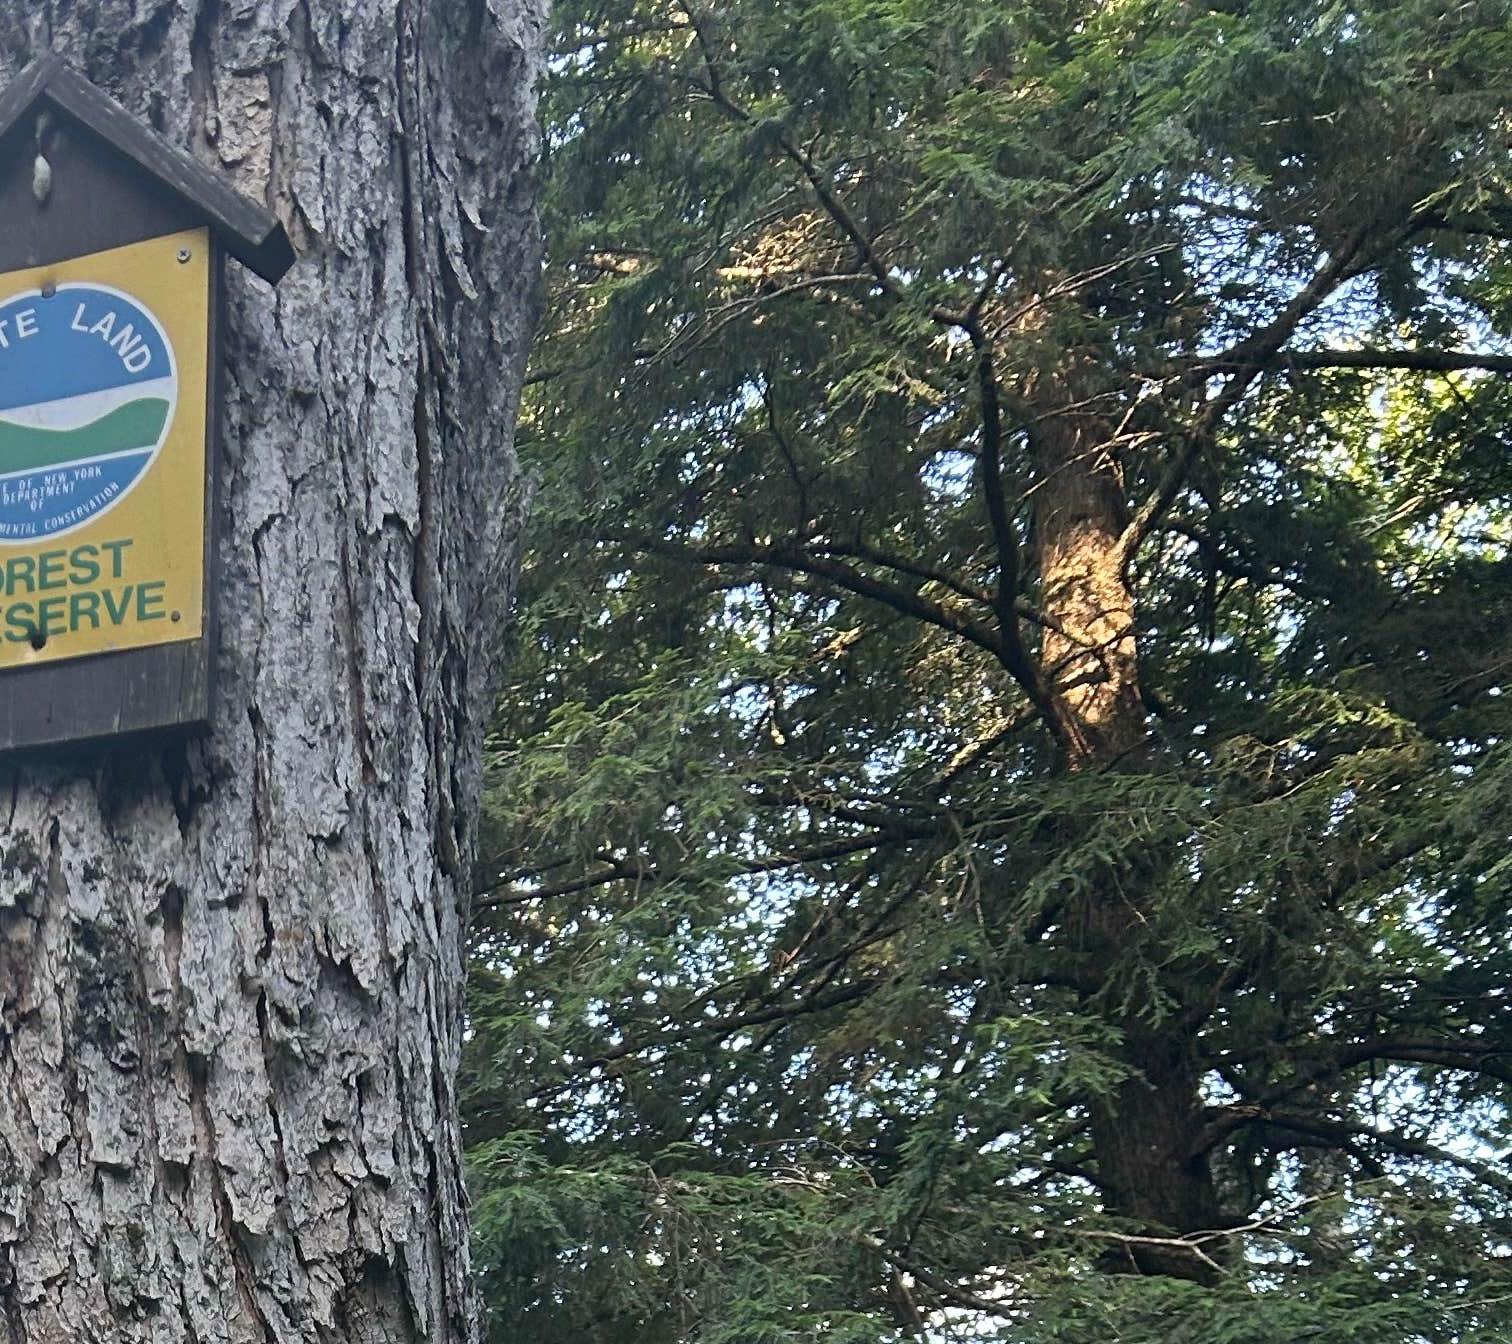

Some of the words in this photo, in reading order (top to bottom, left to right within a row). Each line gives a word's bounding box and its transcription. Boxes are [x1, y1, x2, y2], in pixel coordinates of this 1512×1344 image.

[70, 302, 152, 374] LAND
[18, 477, 33, 490] OF
[44, 472, 67, 486] NEW
[73, 465, 102, 481] YORK
[3, 482, 75, 505] DEPARTMENT
[29, 499, 45, 512] OF
[44, 481, 120, 531] CONSERVATION
